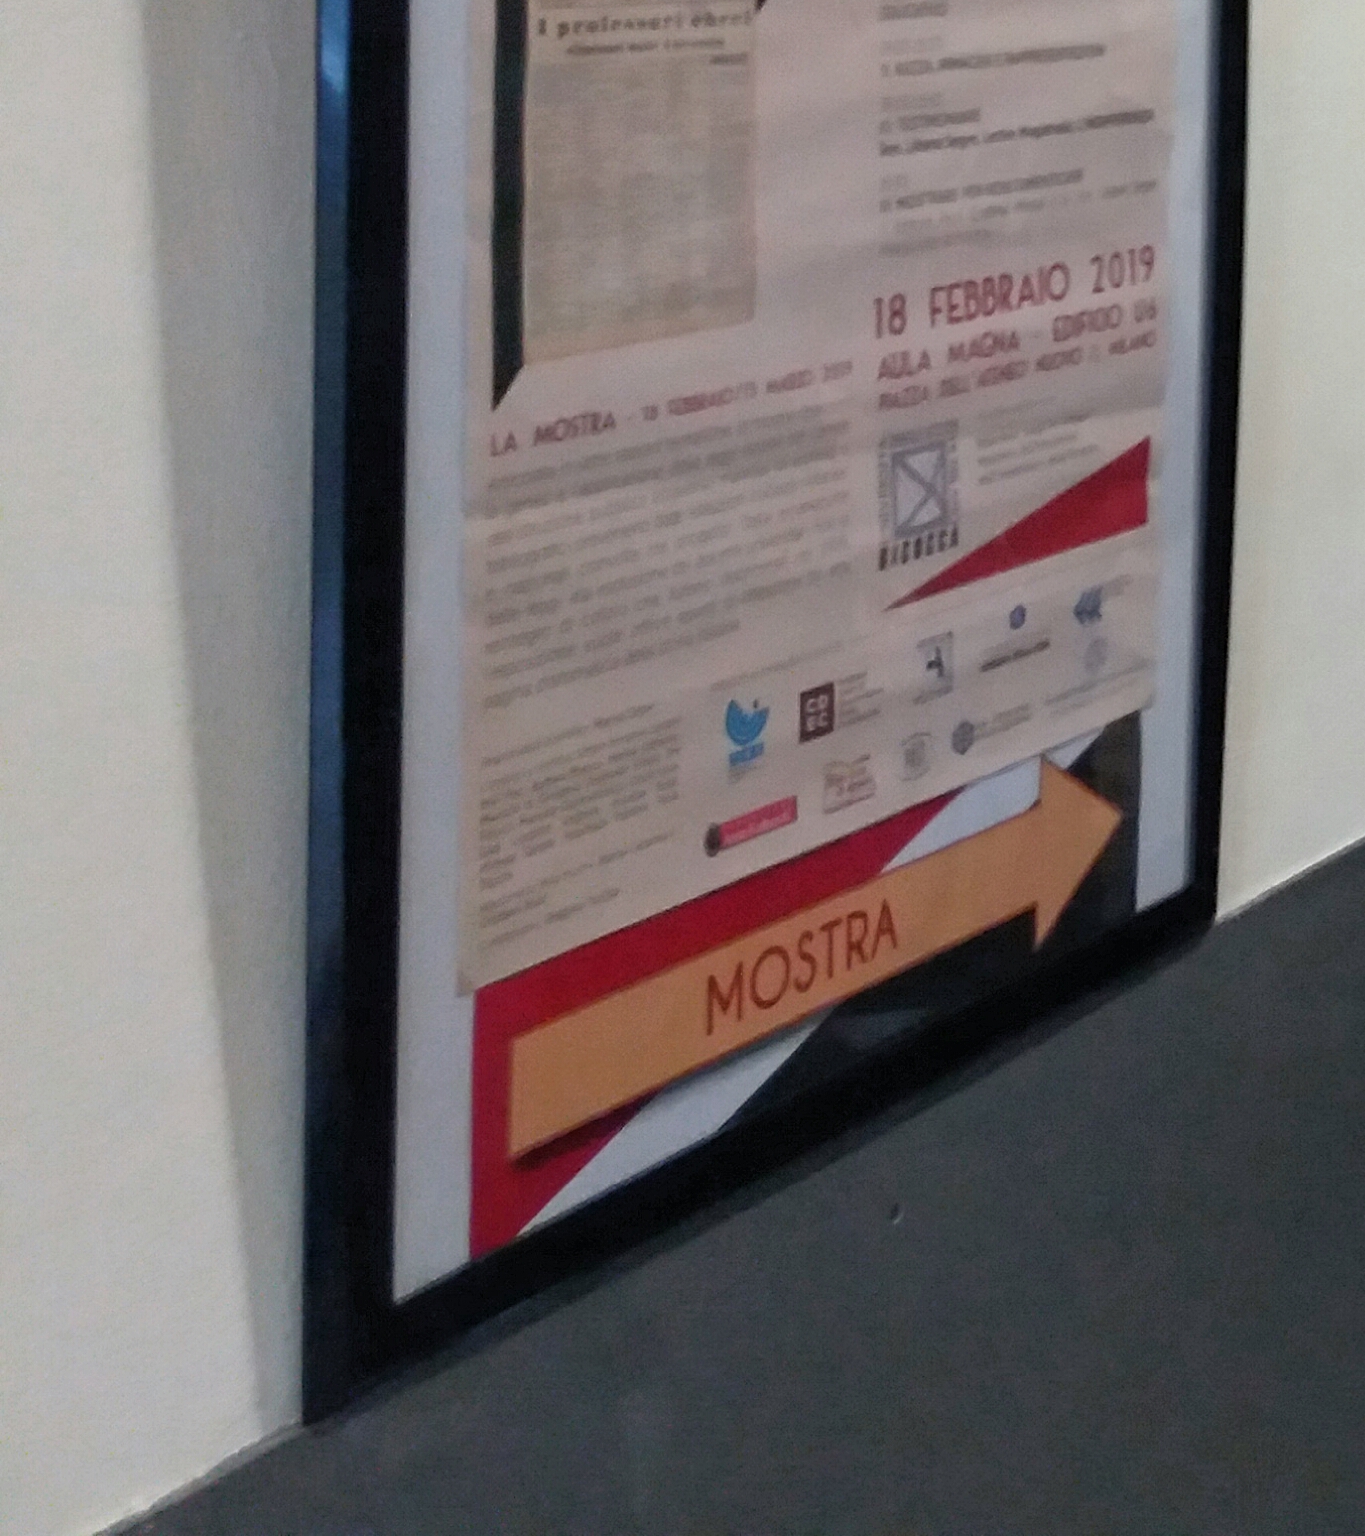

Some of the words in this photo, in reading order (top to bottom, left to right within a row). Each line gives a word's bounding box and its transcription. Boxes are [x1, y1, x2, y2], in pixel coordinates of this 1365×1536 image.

[873, 293, 908, 339] 18
[929, 262, 1071, 329] FEBBRAIO
[1090, 244, 1155, 294] 2019
[490, 432, 518, 458] LA
[533, 412, 617, 447] MOSTRA
[705, 898, 898, 1037] MOSTRA
